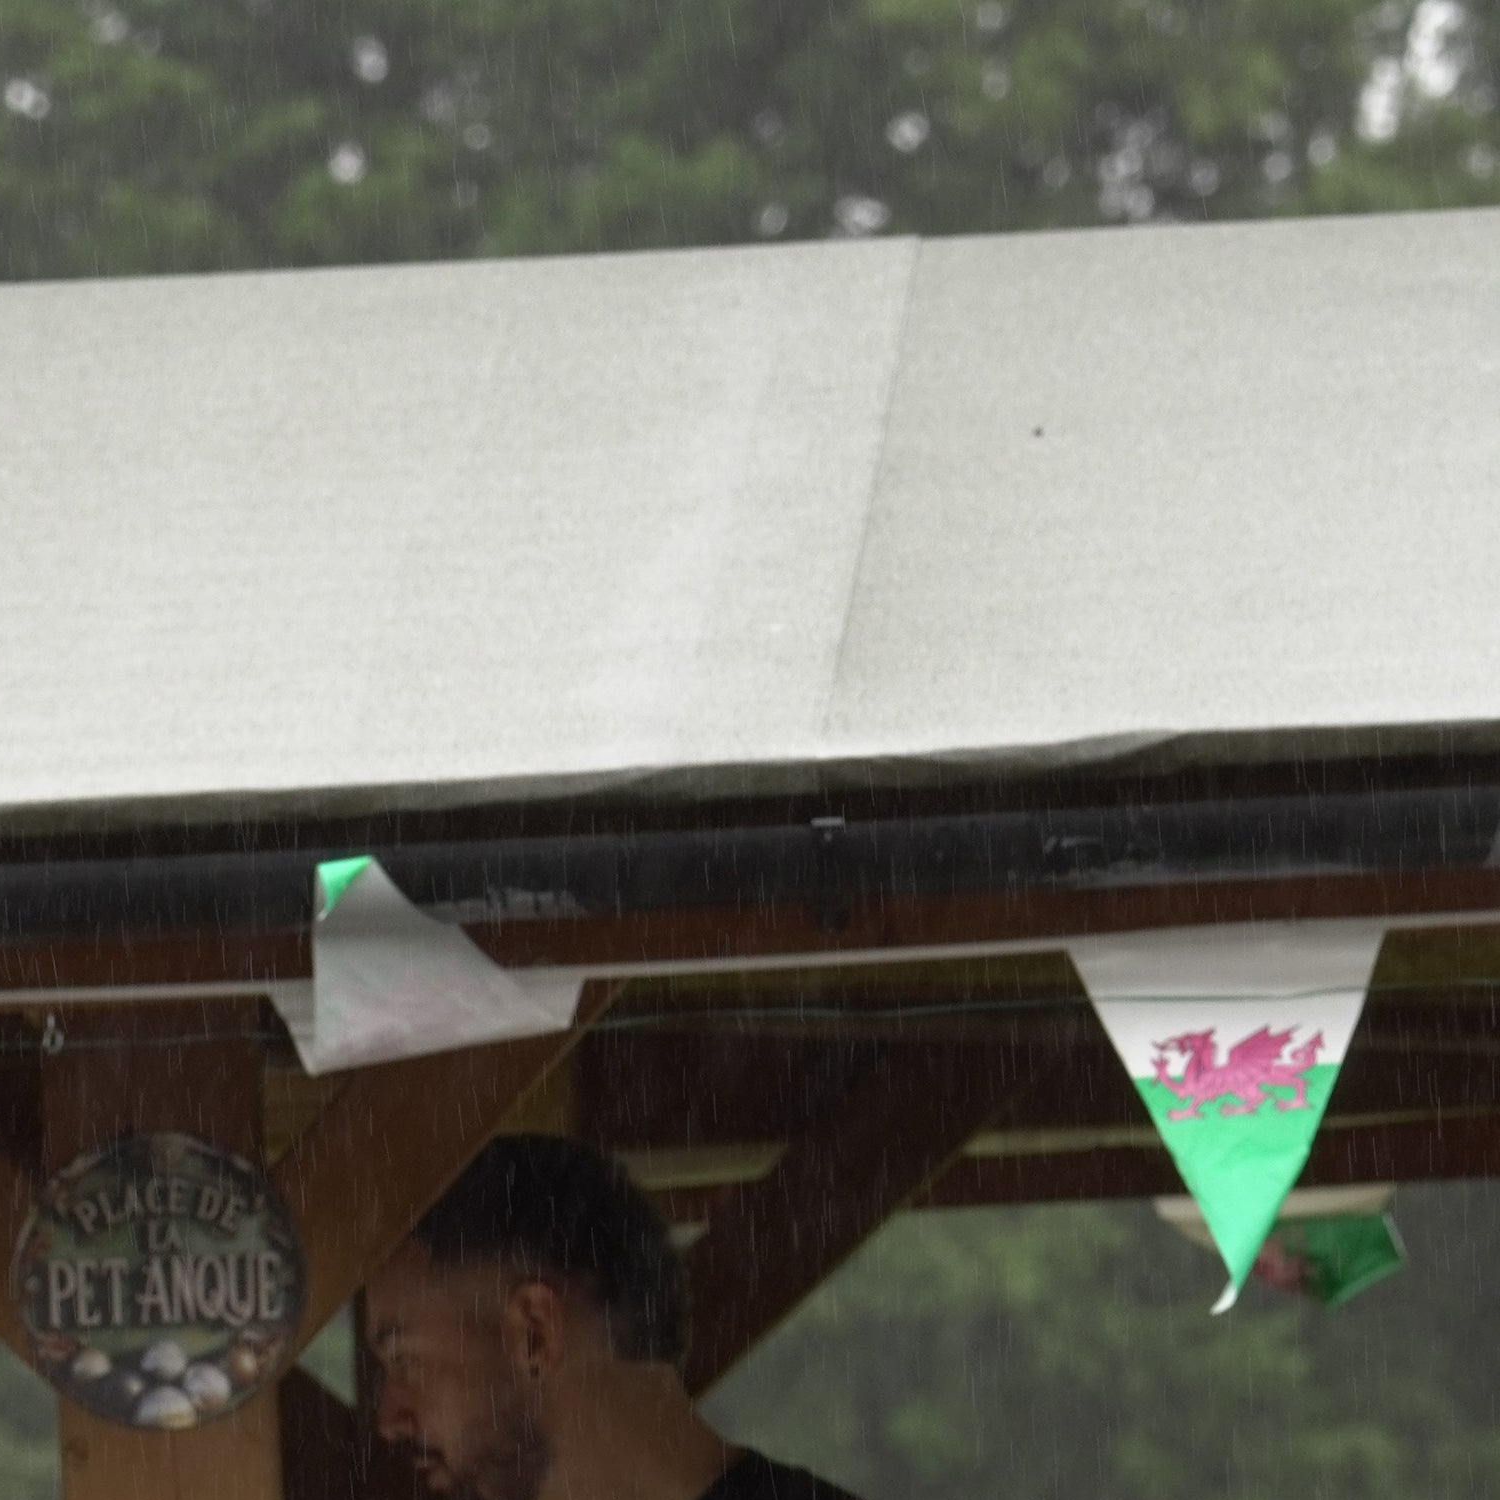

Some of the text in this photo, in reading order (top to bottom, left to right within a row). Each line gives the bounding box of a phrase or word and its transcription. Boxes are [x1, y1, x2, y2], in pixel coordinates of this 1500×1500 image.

[73, 1177, 246, 1234] PLACE DE
[148, 1219, 181, 1252] LA
